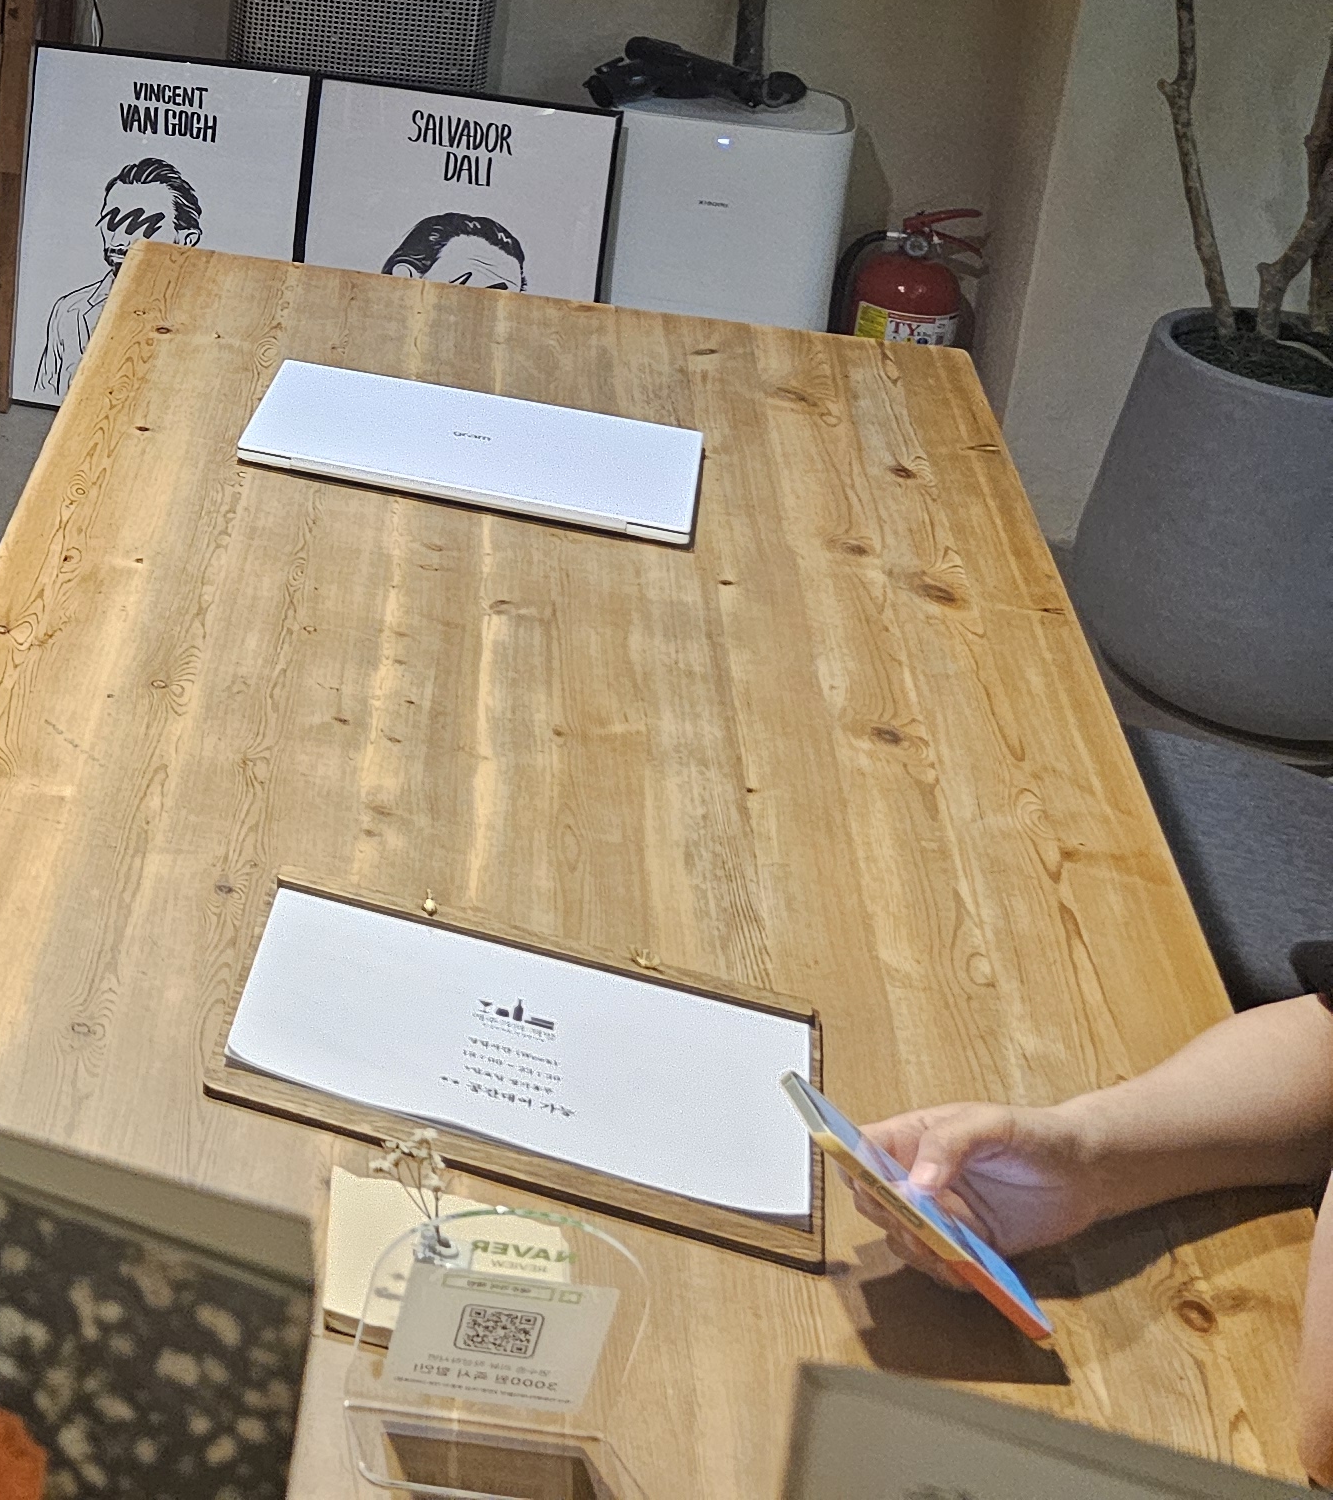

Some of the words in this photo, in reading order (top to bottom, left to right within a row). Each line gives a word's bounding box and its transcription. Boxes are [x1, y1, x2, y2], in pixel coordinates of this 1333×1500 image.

[133, 81, 209, 110] VINCENT
[119, 102, 159, 135] VAN
[164, 108, 218, 144] GOGH
[407, 109, 514, 157] SALVADOR
[443, 151, 493, 187] DALI
[467, 1080, 533, 1108] 공간대여
[539, 1102, 577, 1117] 가능
